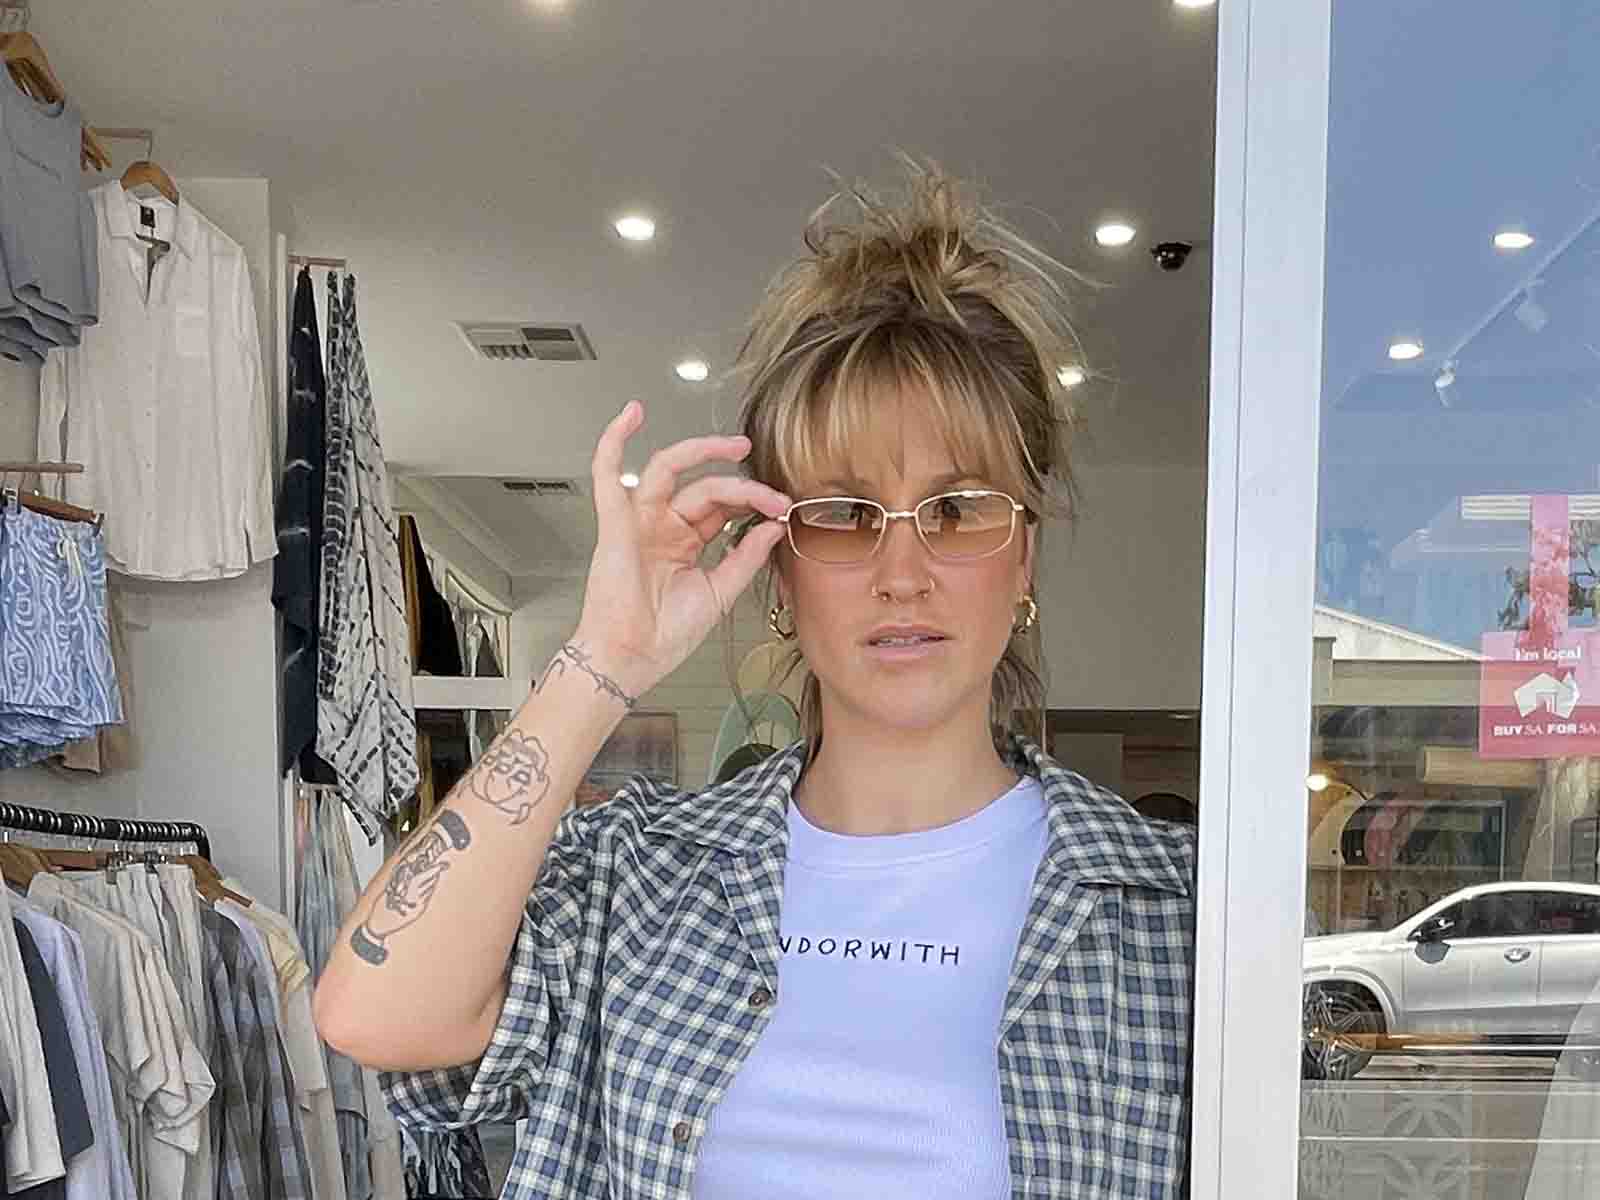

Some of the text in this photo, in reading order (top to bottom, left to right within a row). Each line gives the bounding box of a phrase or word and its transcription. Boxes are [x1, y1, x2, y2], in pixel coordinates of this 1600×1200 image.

[1543, 645, 1582, 660] local
[1493, 723, 1523, 737] BUY
[1546, 722, 1577, 736] FOR
